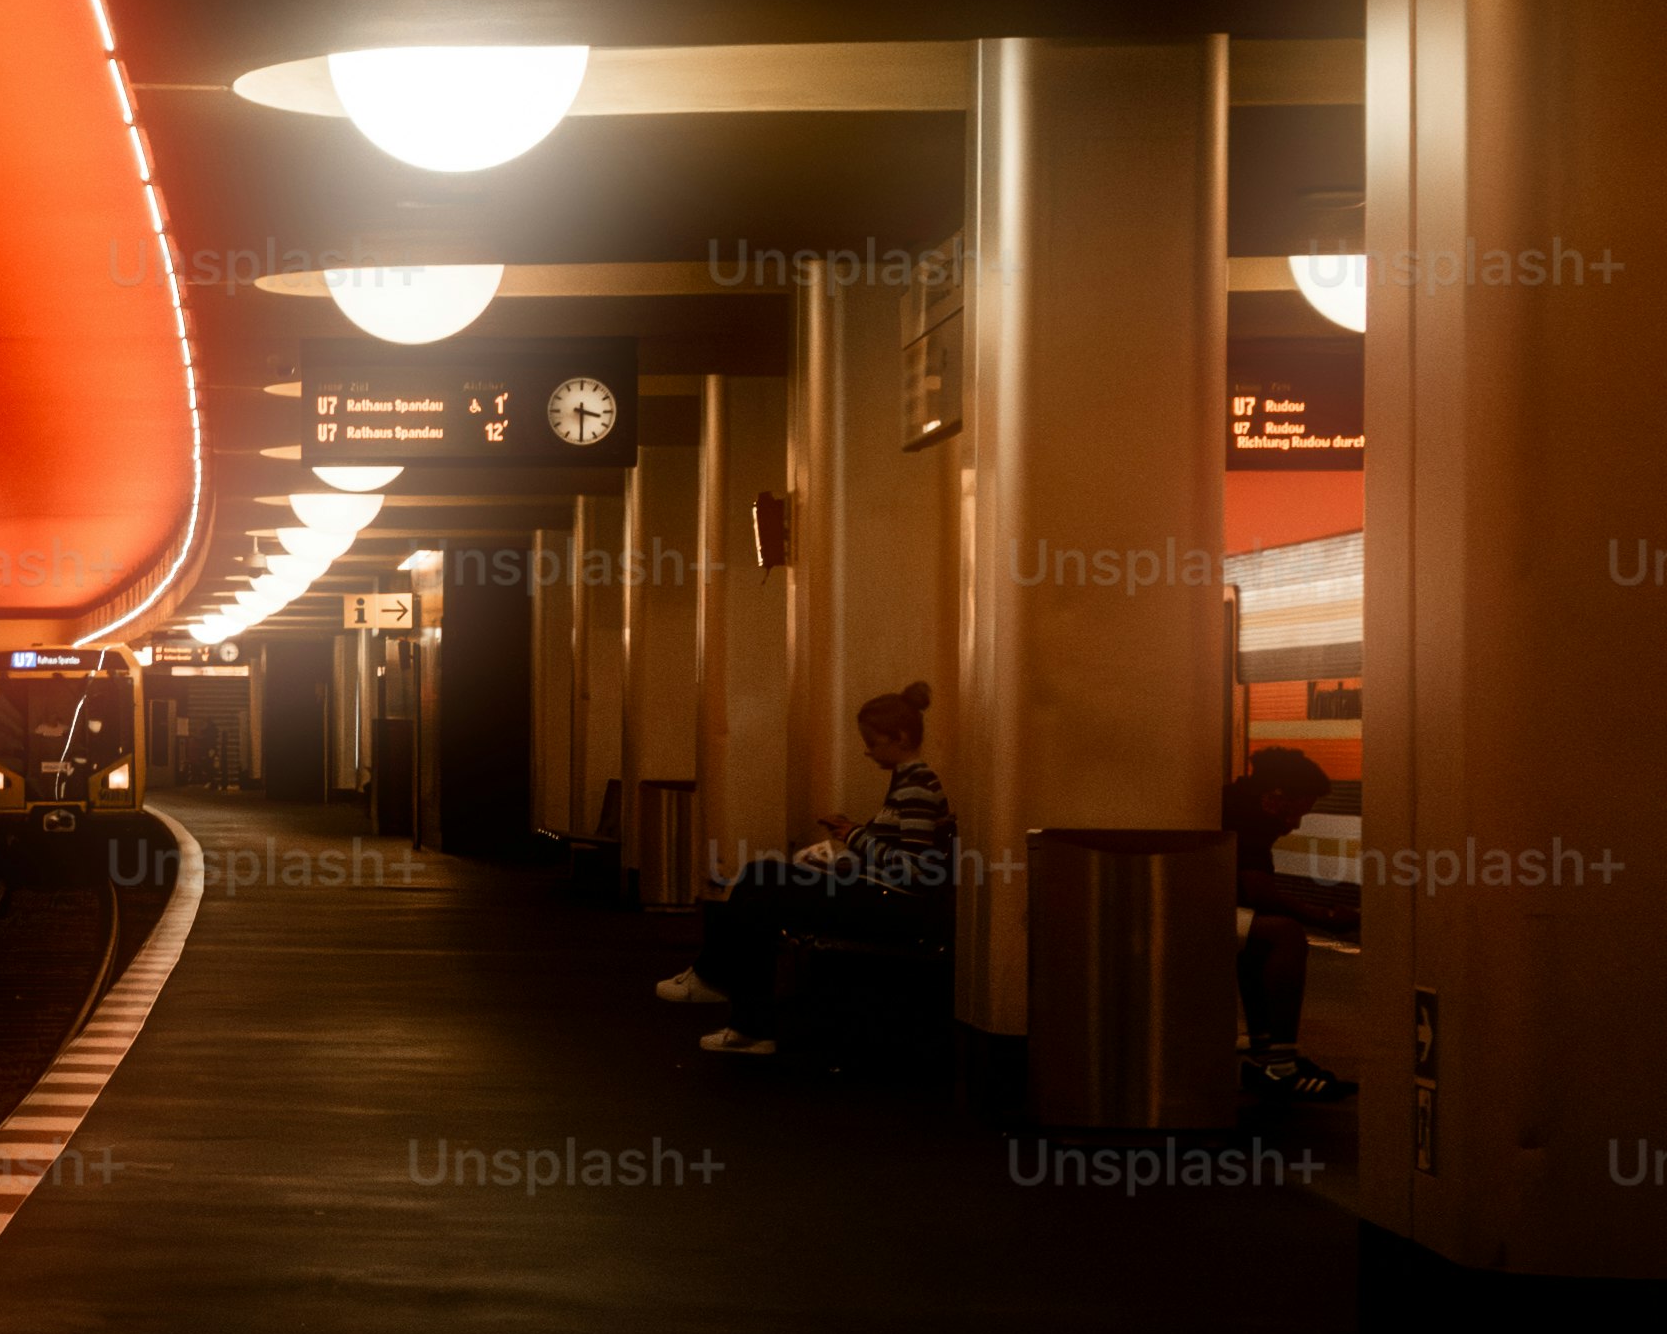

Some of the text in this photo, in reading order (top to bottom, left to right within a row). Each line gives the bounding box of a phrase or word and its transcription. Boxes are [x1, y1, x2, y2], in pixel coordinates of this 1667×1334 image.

[317, 395, 338, 415] U7
[346, 399, 393, 412] Rathaus
[394, 399, 444, 414] Spandau
[1233, 396, 1305, 416] U7 Rudow
[317, 422, 338, 442] U7
[346, 426, 393, 439] Rathaus
[394, 426, 444, 441] Spandau
[1233, 422, 1305, 435] U7 Rudow
[1237, 436, 1290, 450] Richtung
[1291, 436, 1331, 449] Rudow
[13, 652, 34, 668] U7
